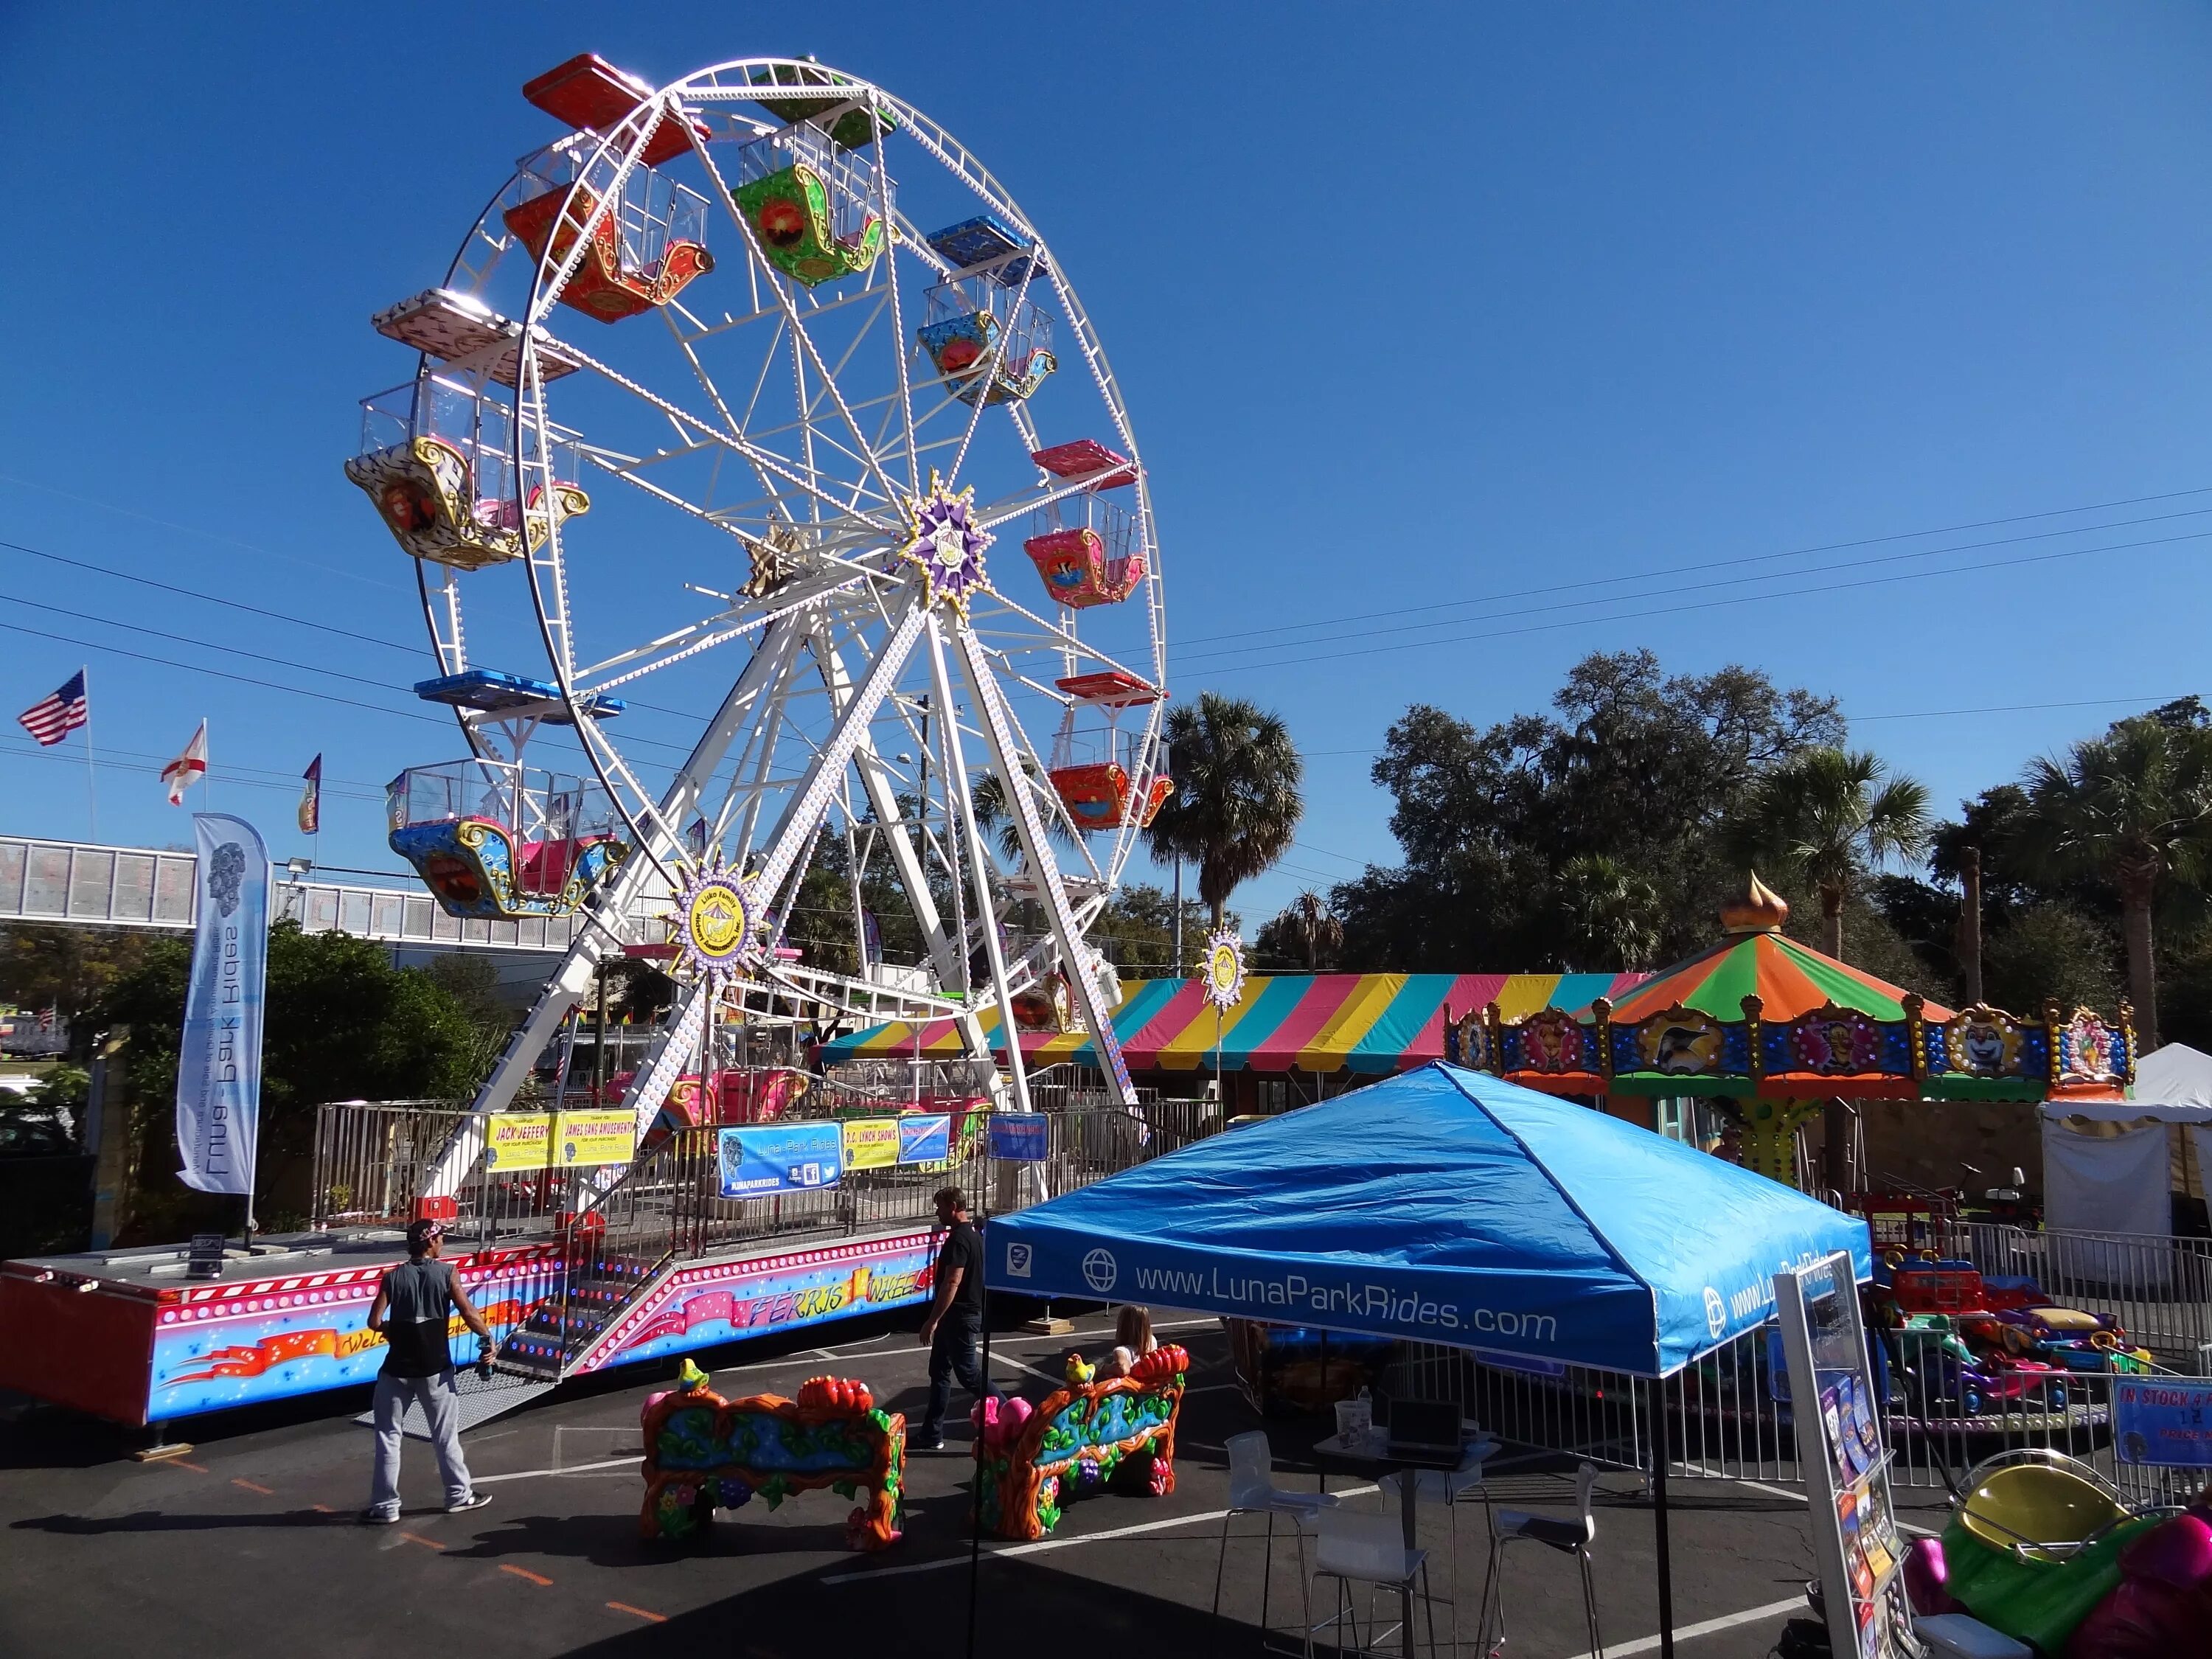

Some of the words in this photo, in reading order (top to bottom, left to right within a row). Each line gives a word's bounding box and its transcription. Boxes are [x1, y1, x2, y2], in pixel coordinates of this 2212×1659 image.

[701, 892, 717, 905] Lisko
[719, 891, 737, 908] Family
[695, 913, 705, 941] Midway
[496, 1127, 516, 1141] JACK
[518, 1124, 550, 1139] JEFFERY
[566, 1123, 582, 1136] JAMES
[585, 1123, 598, 1135] GANG
[846, 1132, 857, 1143] D.C.
[860, 1130, 875, 1142] LYNCH
[877, 1129, 896, 1141] SHOWS
[811, 1138, 837, 1151] Rides
[749, 1286, 843, 1326] FERRIS
[867, 1268, 926, 1302] WHEEL
[1135, 1267, 1557, 1341] www.LunaParkRides.com
[342, 1330, 385, 1353] Welc
[2120, 1388, 2135, 1403] IN
[2142, 1388, 2188, 1406] STOCK
[2159, 1428, 2199, 1439] PRICE
